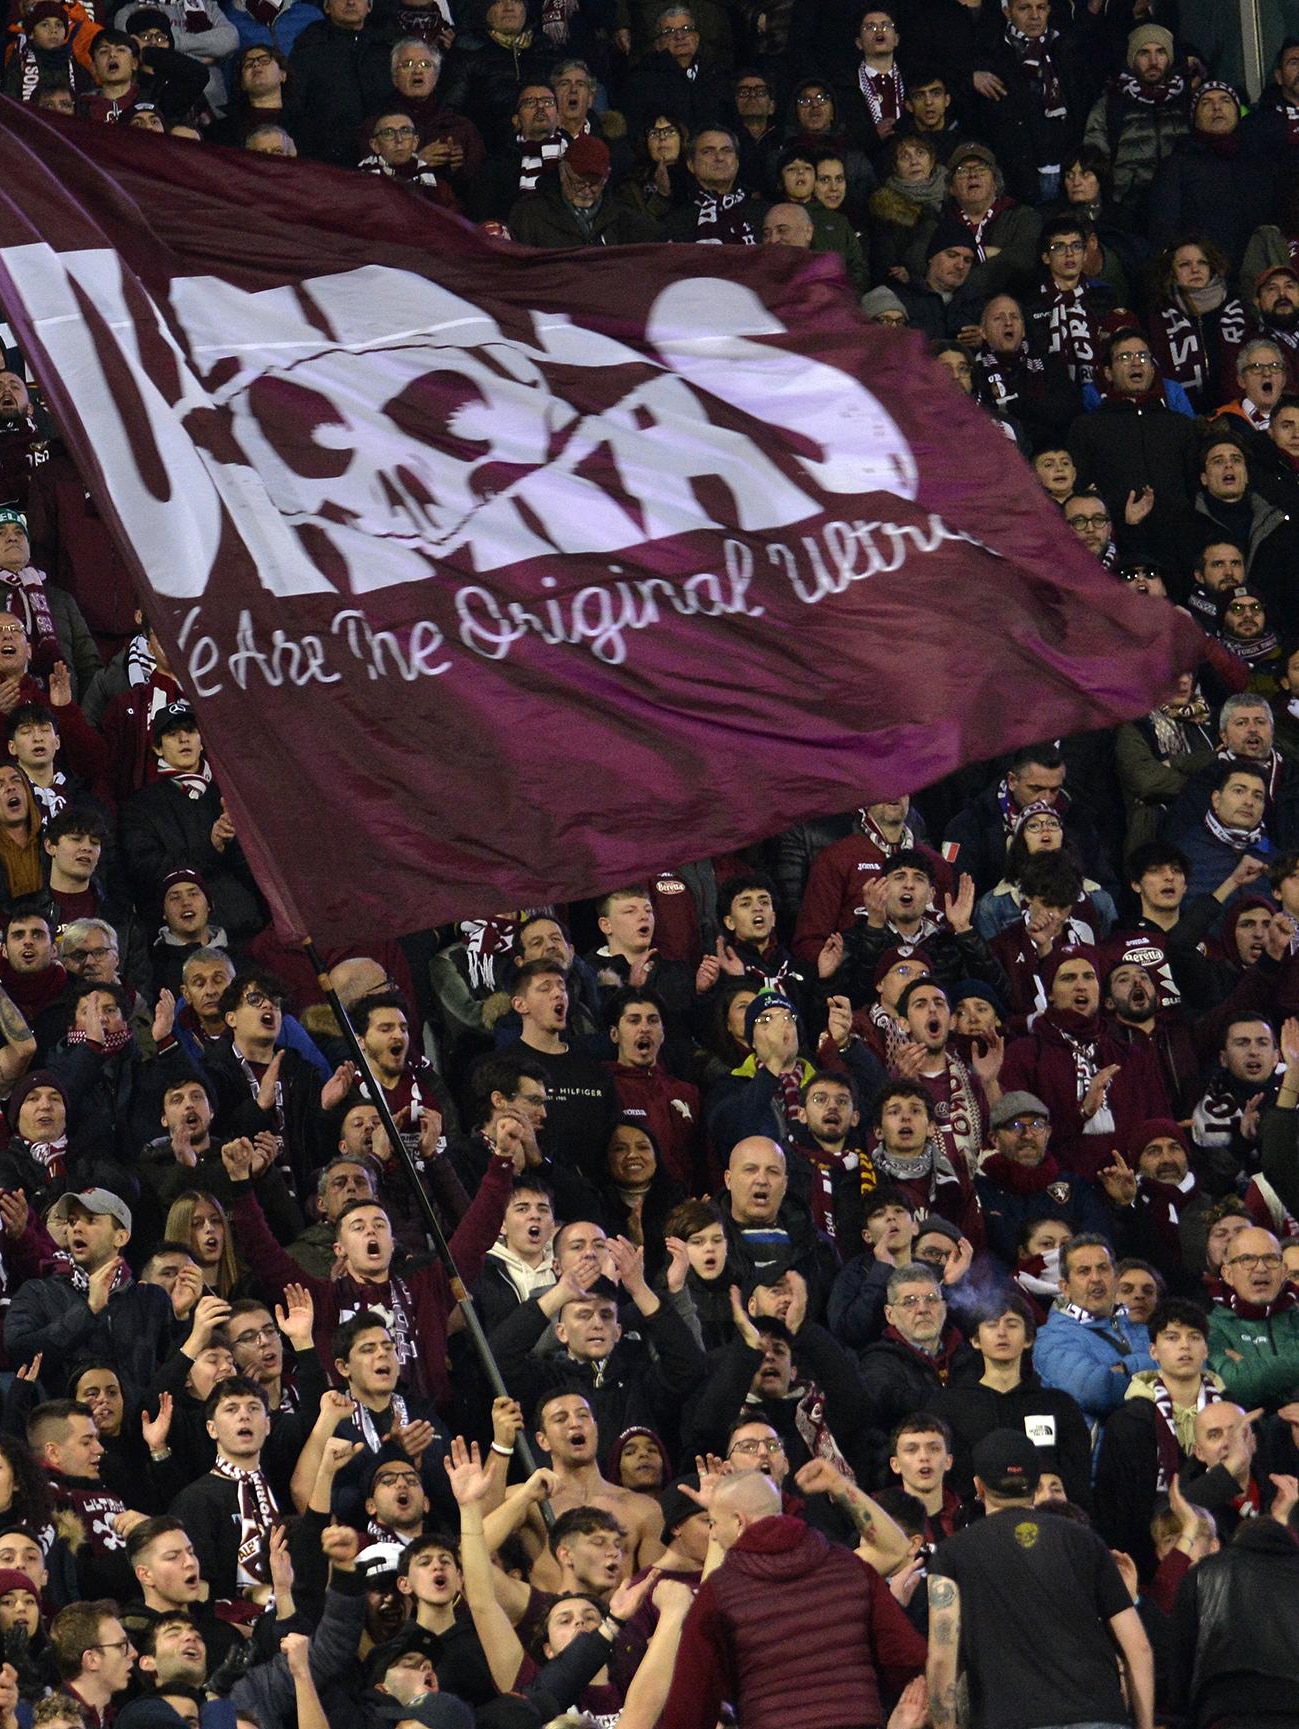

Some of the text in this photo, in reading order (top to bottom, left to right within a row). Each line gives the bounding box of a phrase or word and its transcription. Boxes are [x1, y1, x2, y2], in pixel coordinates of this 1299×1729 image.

[228, 609, 340, 689] Are
[332, 608, 452, 681] The
[455, 538, 764, 665] Original
[559, 1088, 603, 1098] HILFIGER
